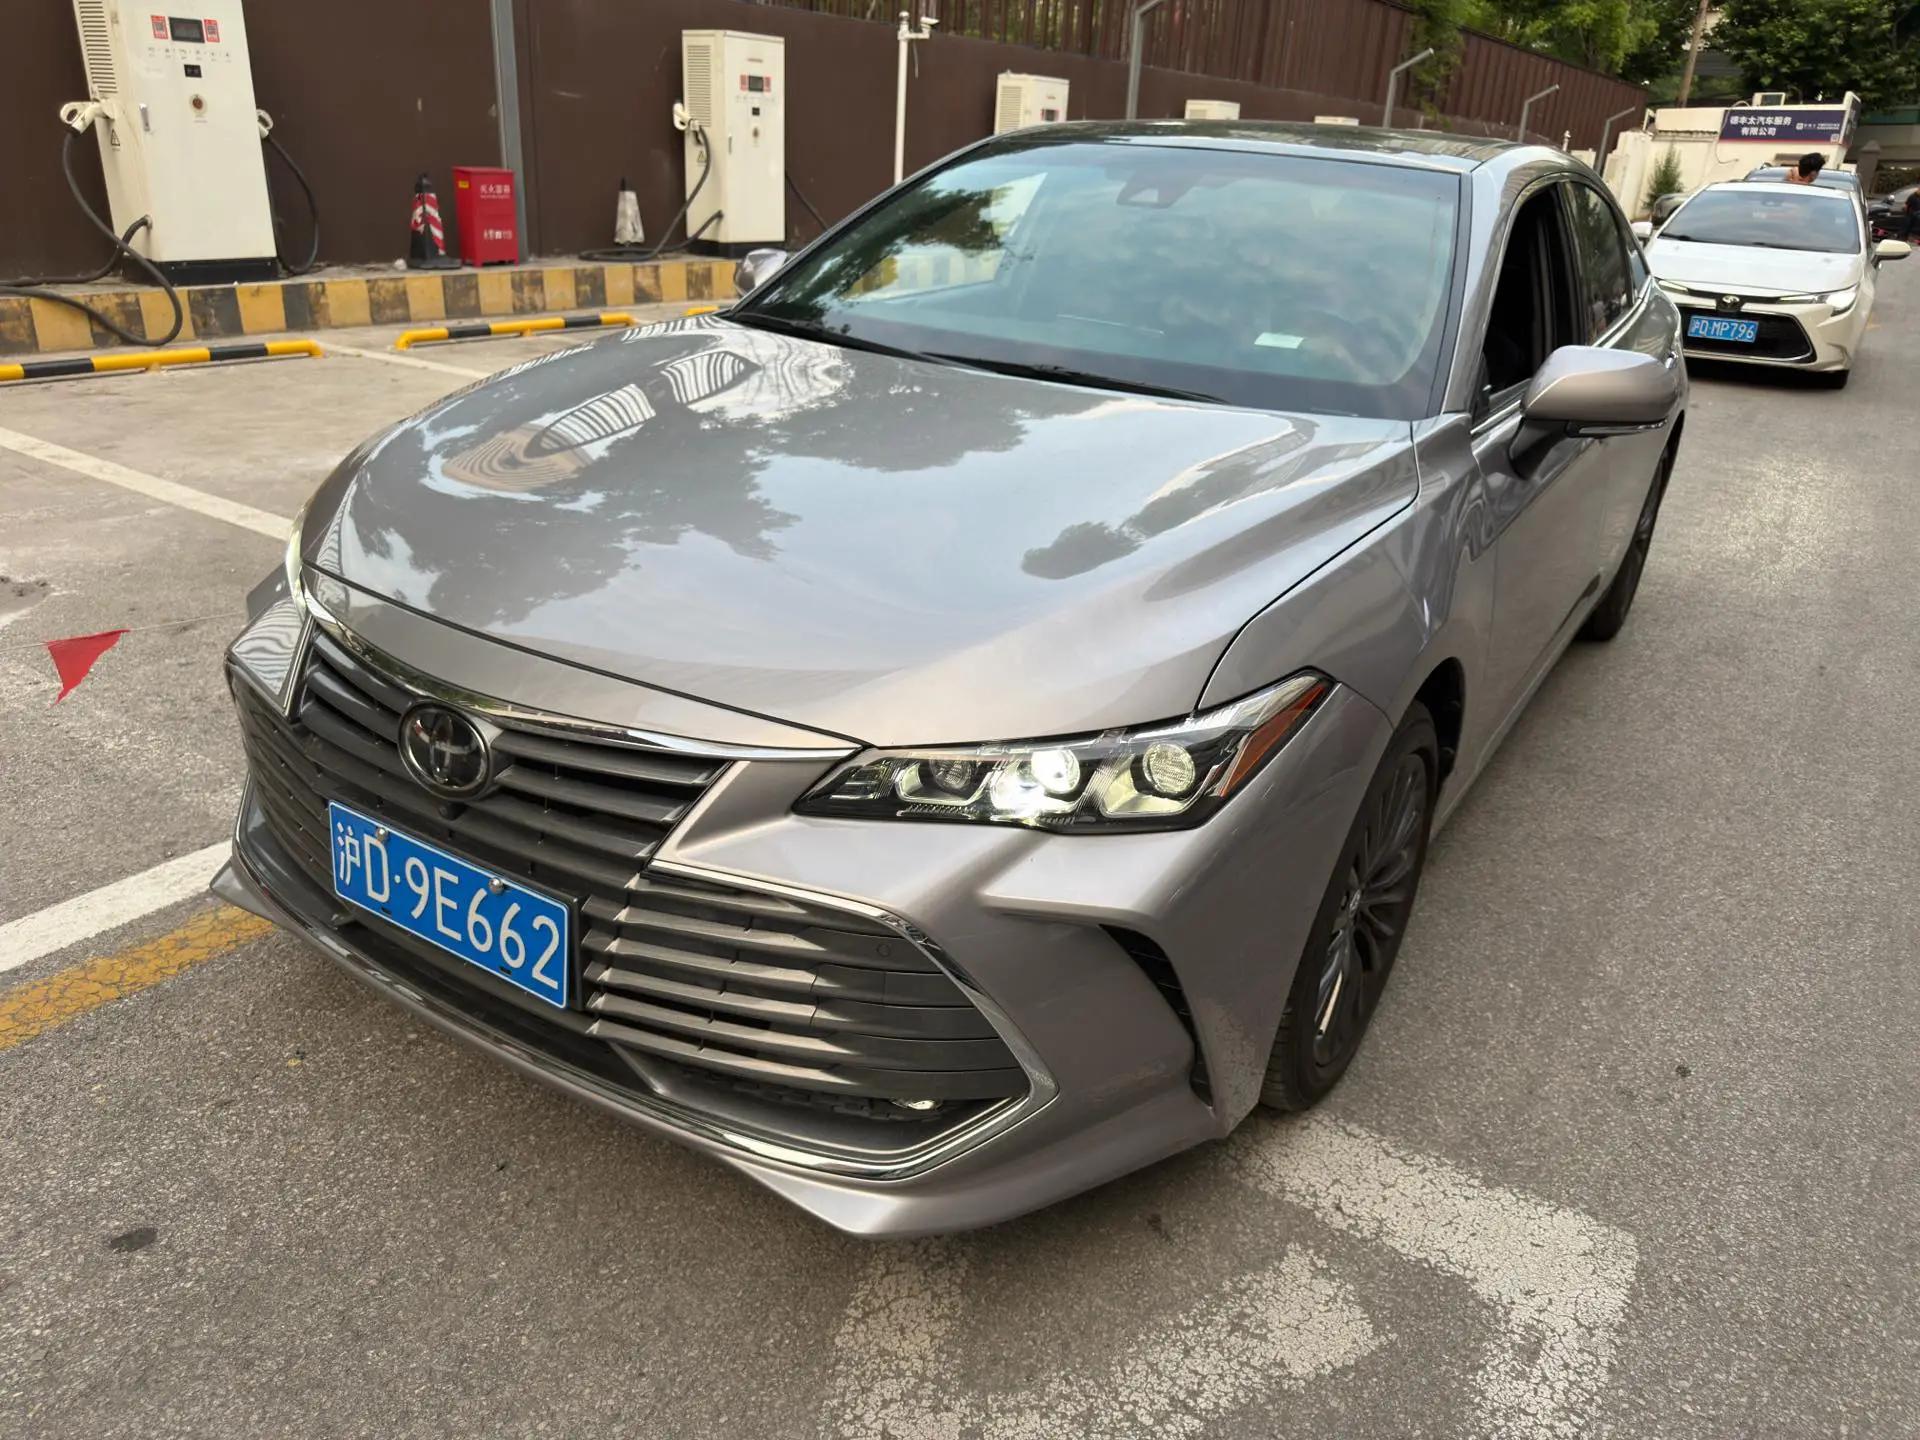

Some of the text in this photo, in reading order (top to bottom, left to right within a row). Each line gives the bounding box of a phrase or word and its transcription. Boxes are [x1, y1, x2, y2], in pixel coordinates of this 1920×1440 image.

[1741, 127, 1777, 136] 有限公司
[336, 821, 561, 990] 沪D·9E662
